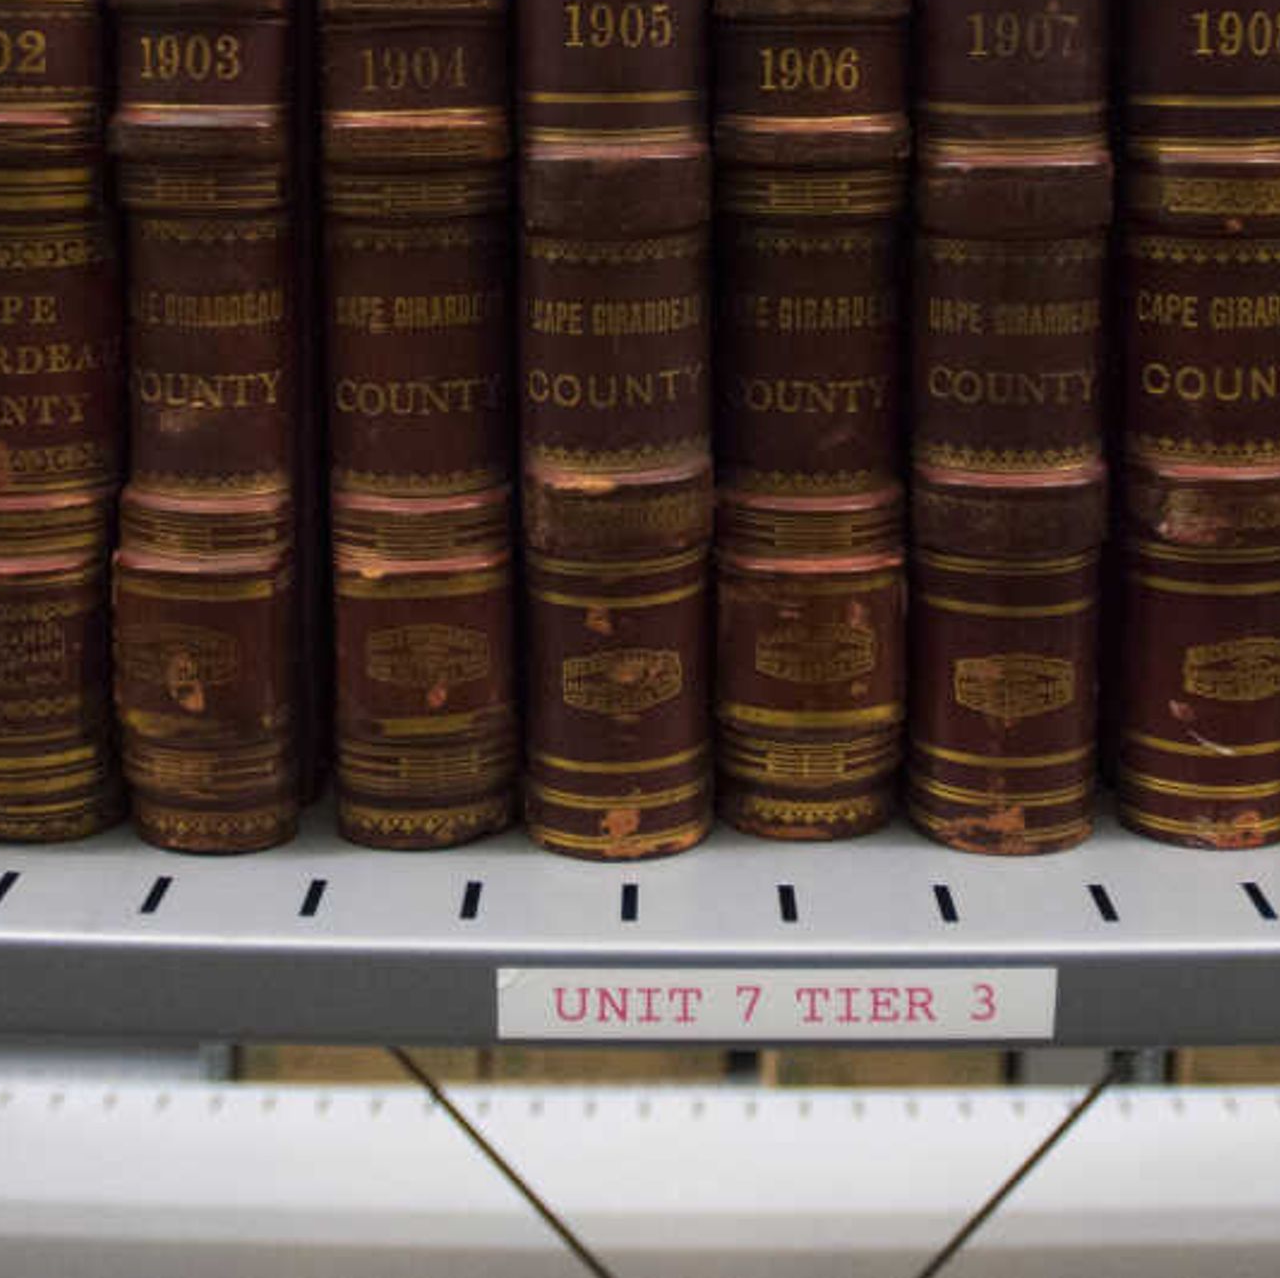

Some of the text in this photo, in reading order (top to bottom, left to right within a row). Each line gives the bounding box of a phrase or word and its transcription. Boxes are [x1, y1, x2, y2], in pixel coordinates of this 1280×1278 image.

[563, 1, 673, 48] 1905
[966, 12, 1082, 59] 1907
[140, 34, 240, 80] 1903
[758, 45, 861, 92] 1906
[1137, 290, 1200, 330] CAPE
[554, 984, 998, 1022] UNIT 7 TIER 3
